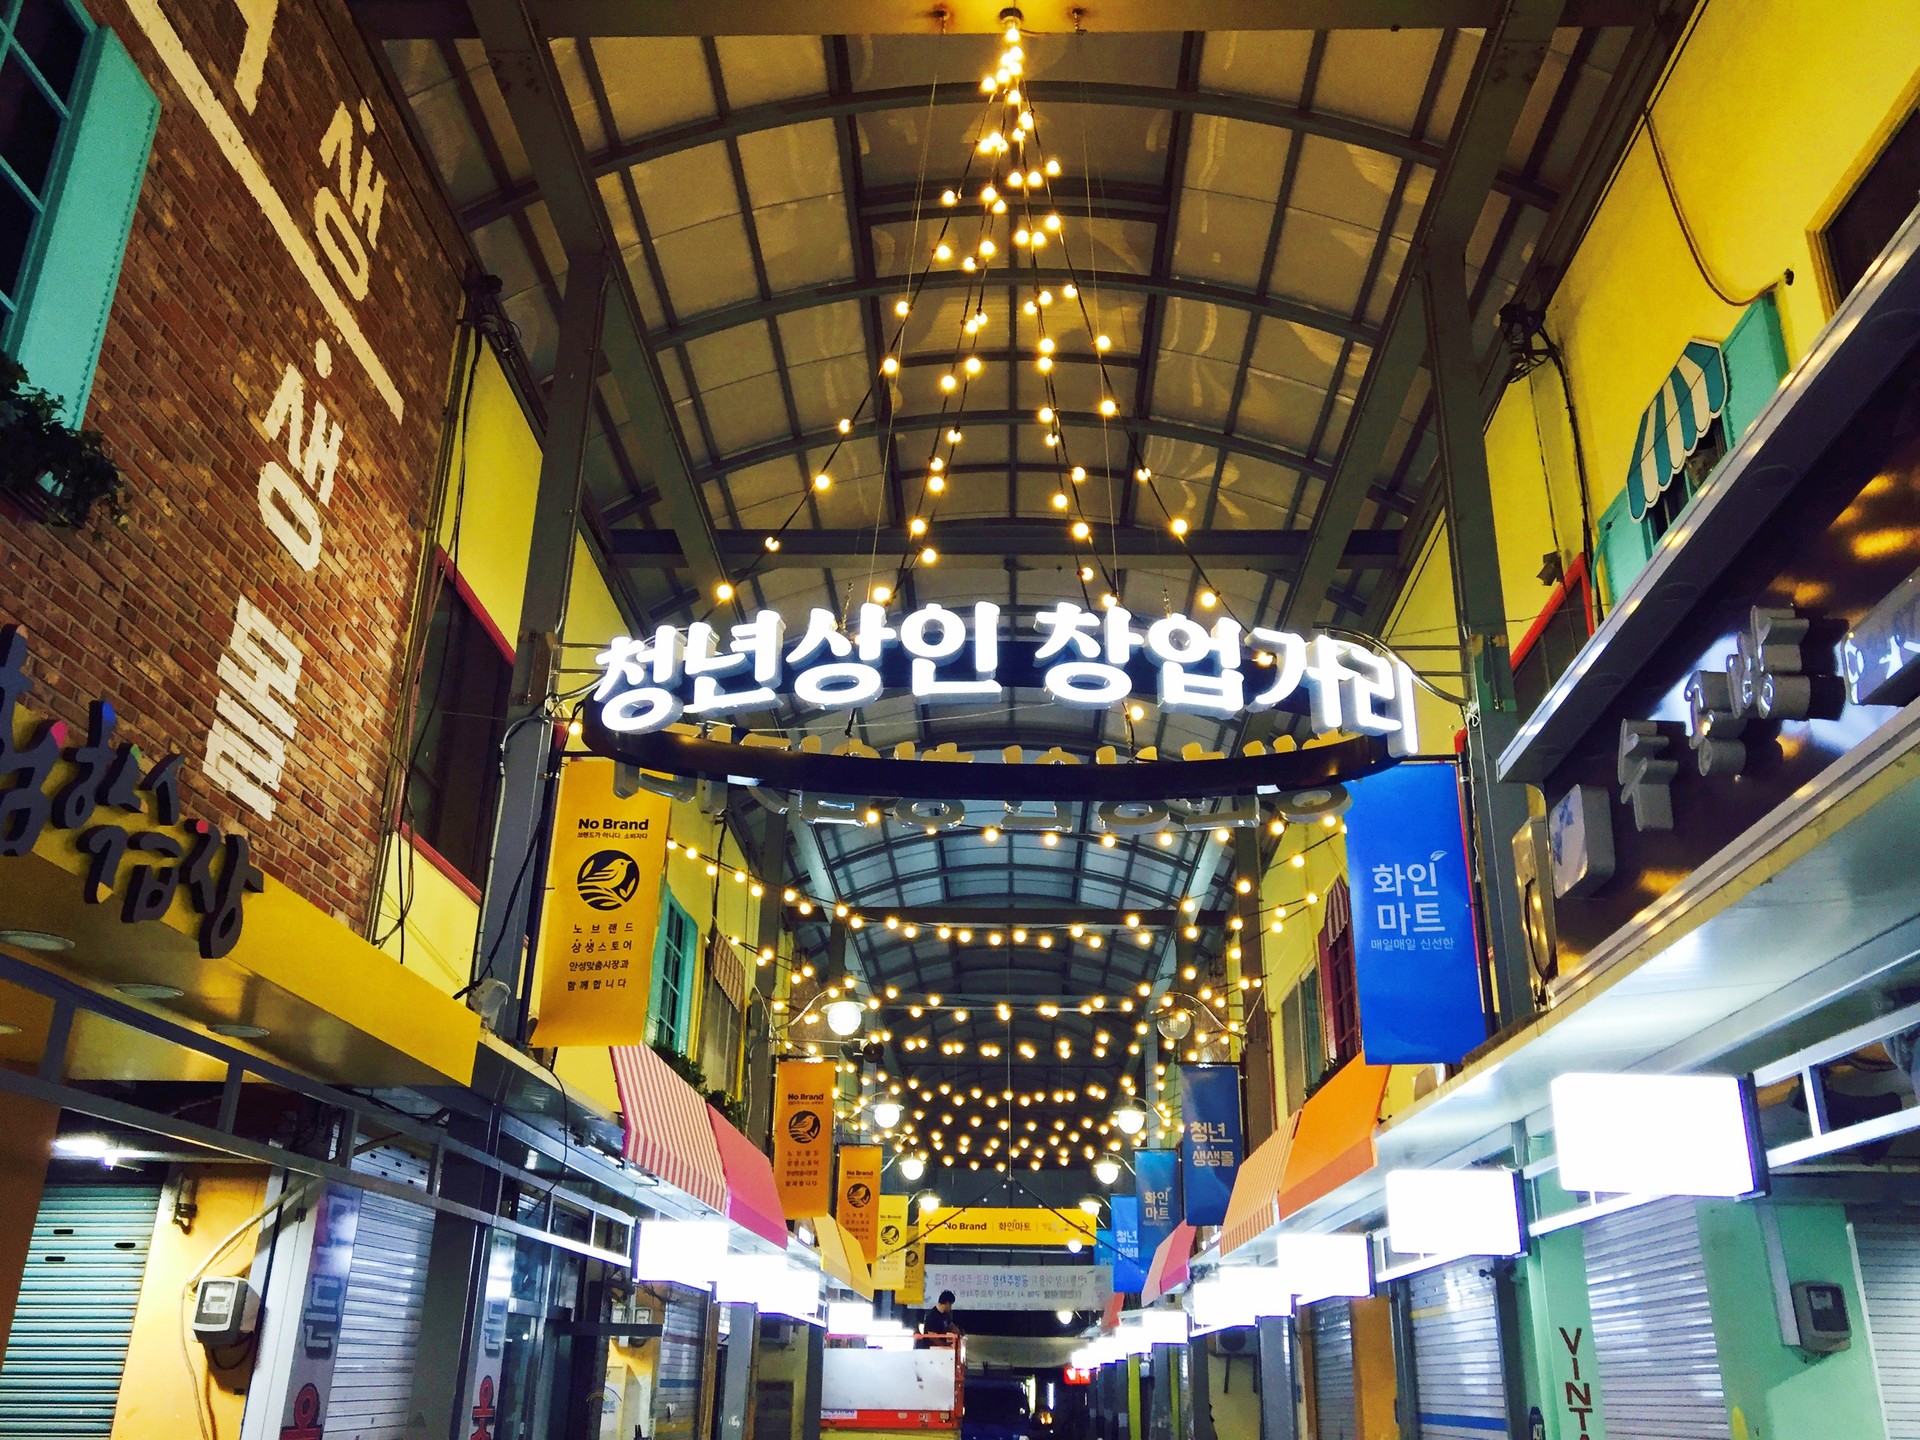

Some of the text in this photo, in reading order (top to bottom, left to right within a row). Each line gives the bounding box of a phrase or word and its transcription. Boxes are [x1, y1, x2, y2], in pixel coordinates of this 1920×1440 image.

[593, 602, 1419, 757] 청년상인 창업거리
[578, 818, 649, 830] No Brand
[1372, 862, 1439, 897] 화인
[1377, 902, 1446, 936] 마트
[1370, 936, 1455, 952] 매일매일 신선한
[568, 959, 630, 972] 안성맞춤시장과
[566, 978, 627, 992] 함께합니다
[1190, 1121, 1234, 1143] 청년
[1192, 1146, 1234, 1168] 생생몰
[1144, 1190, 1169, 1206] 화인
[1145, 1206, 1170, 1220] 마트
[944, 1222, 987, 1230] No Brand
[998, 1220, 1032, 1232] 화인마트
[1116, 1230, 1138, 1244] 청년
[1558, 1326, 1594, 1440] VINT
